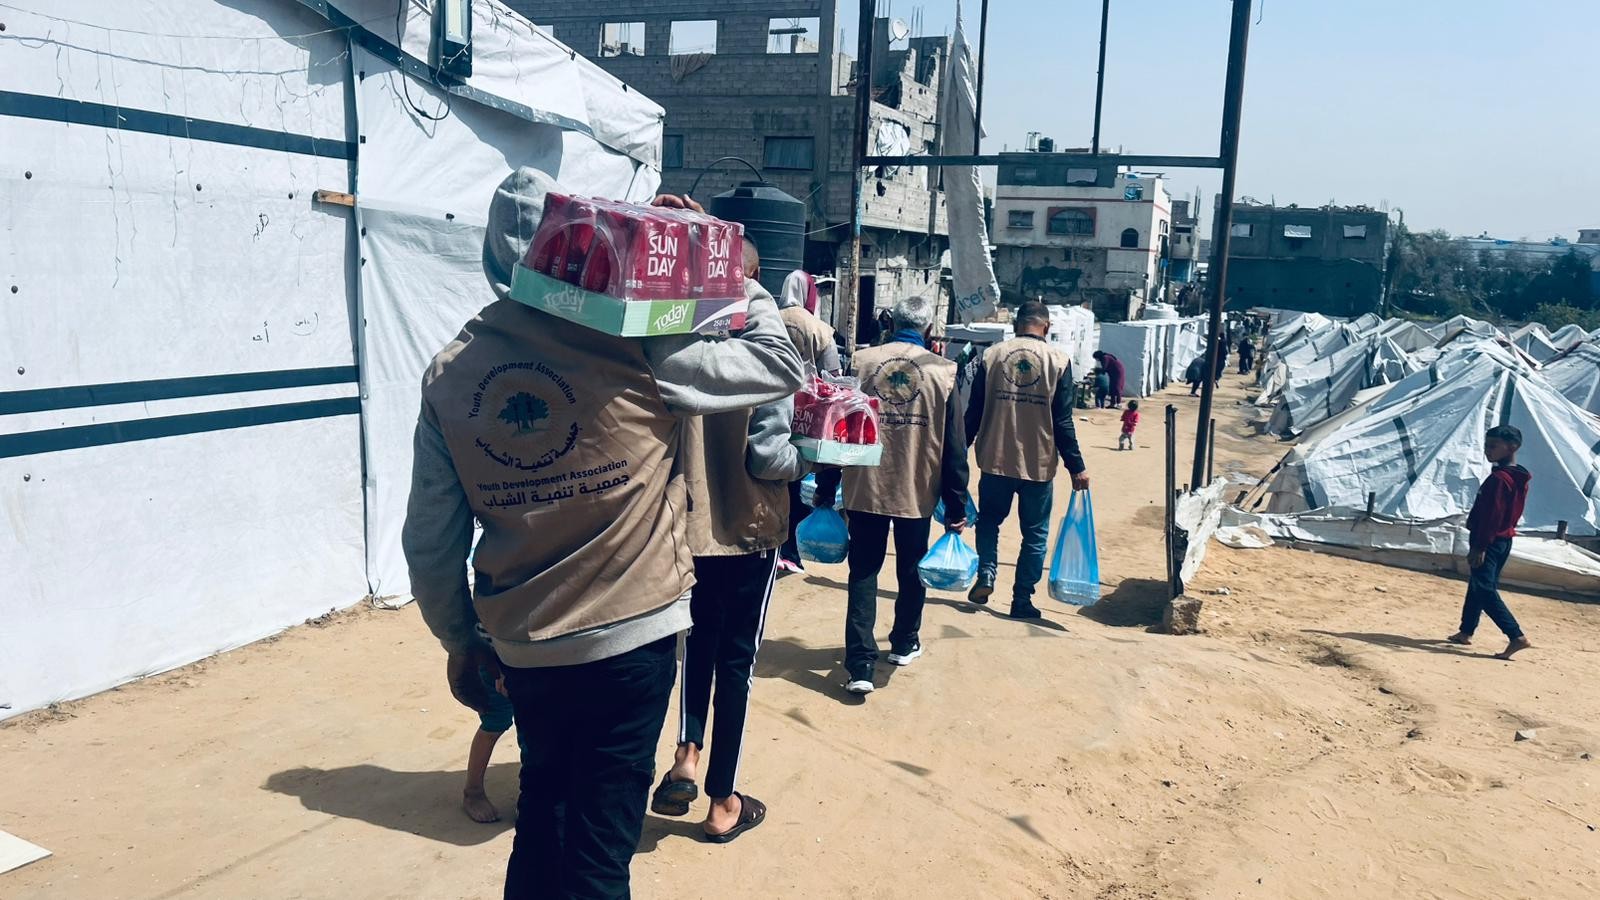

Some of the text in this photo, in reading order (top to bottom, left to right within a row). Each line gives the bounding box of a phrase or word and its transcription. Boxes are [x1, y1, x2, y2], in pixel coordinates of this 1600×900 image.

[649, 234, 678, 257] SUN
[708, 239, 730, 259] SUN
[647, 257, 676, 277] DAY
[707, 260, 728, 278] DAY
[653, 302, 690, 331] Today
[468, 361, 577, 419] Youth Development Association
[793, 409, 814, 423] SUN
[477, 459, 628, 492] Youth Development Association
